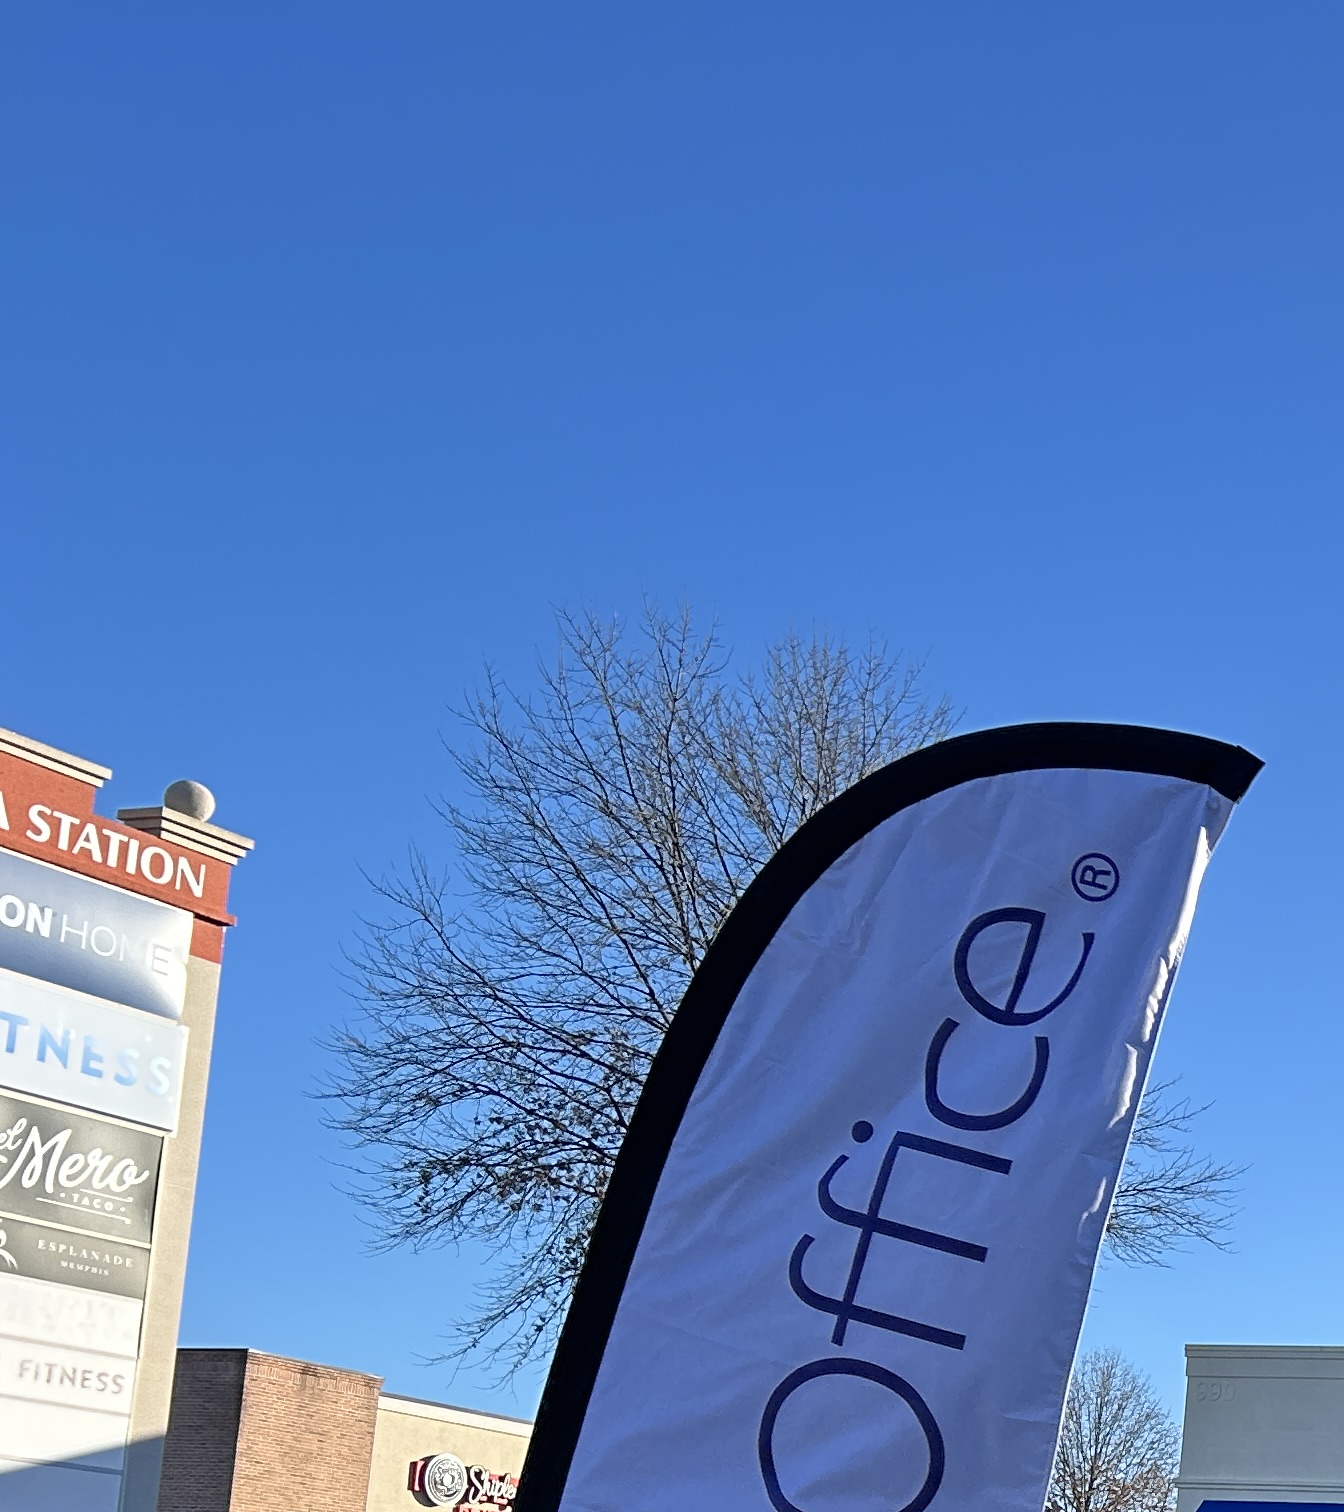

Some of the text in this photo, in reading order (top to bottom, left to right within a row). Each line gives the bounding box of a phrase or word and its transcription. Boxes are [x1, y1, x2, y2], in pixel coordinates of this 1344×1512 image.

[25, 804, 206, 898] STATION
[0, 1125, 150, 1194] Mero
[71, 1192, 115, 1212] TACO
[37, 1238, 135, 1268] ESPLANADE
[60, 1259, 110, 1277] MEMPHIS
[18, 1359, 126, 1395] FITNESS
[469, 1465, 518, 1505] Shiple
